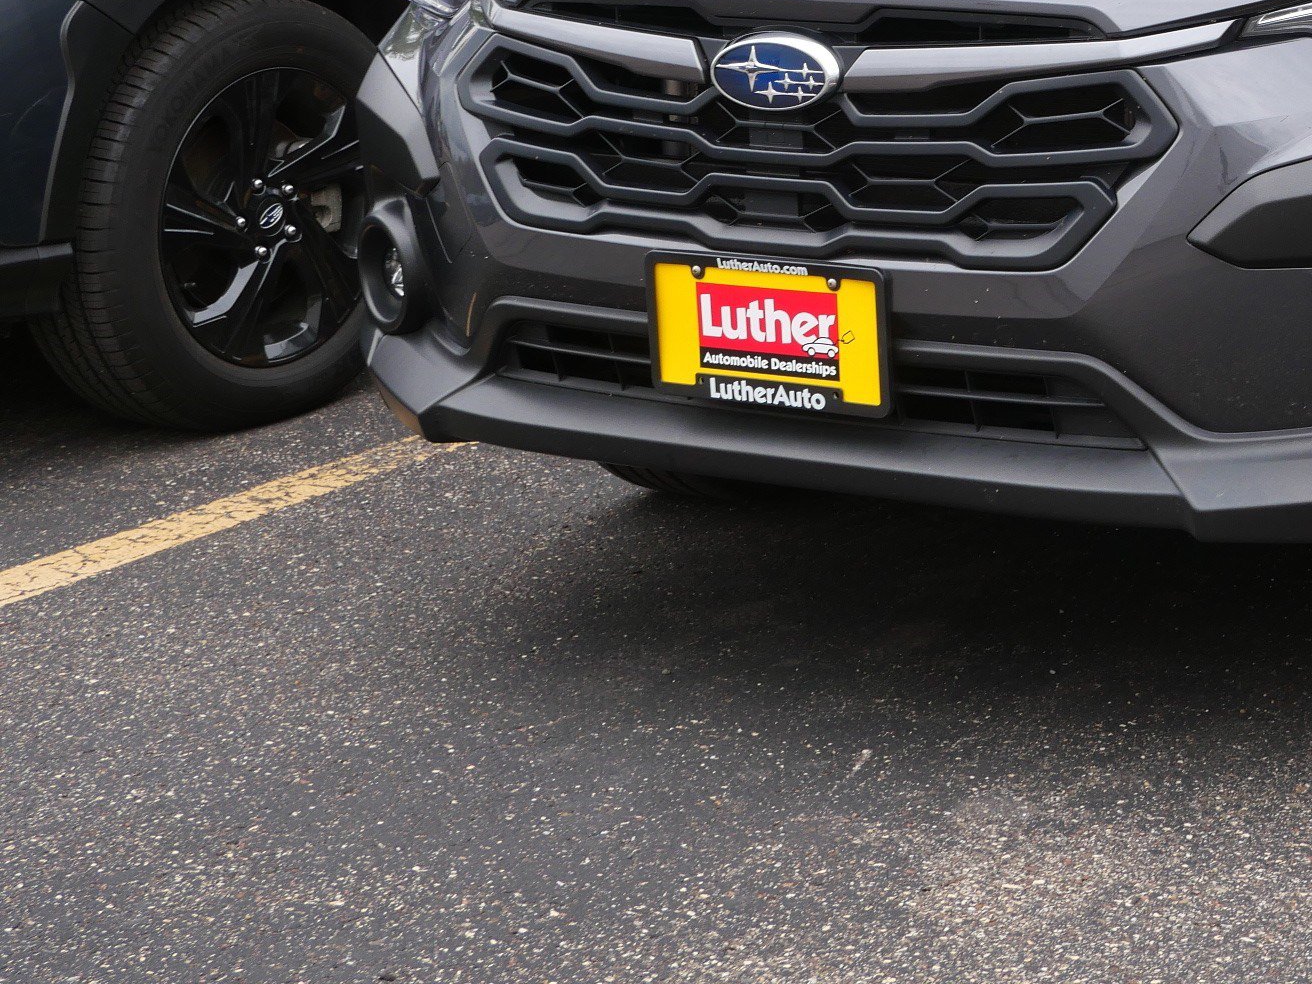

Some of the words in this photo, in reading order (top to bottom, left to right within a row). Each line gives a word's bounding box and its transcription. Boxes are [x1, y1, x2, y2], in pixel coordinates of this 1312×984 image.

[145, 46, 234, 152] YOKOHAMA
[717, 258, 808, 276] LutherAuto.com
[700, 293, 836, 347] Luther
[703, 351, 769, 370] Automobile
[771, 357, 837, 377] Dealerships
[708, 376, 826, 411] LutherAuto
